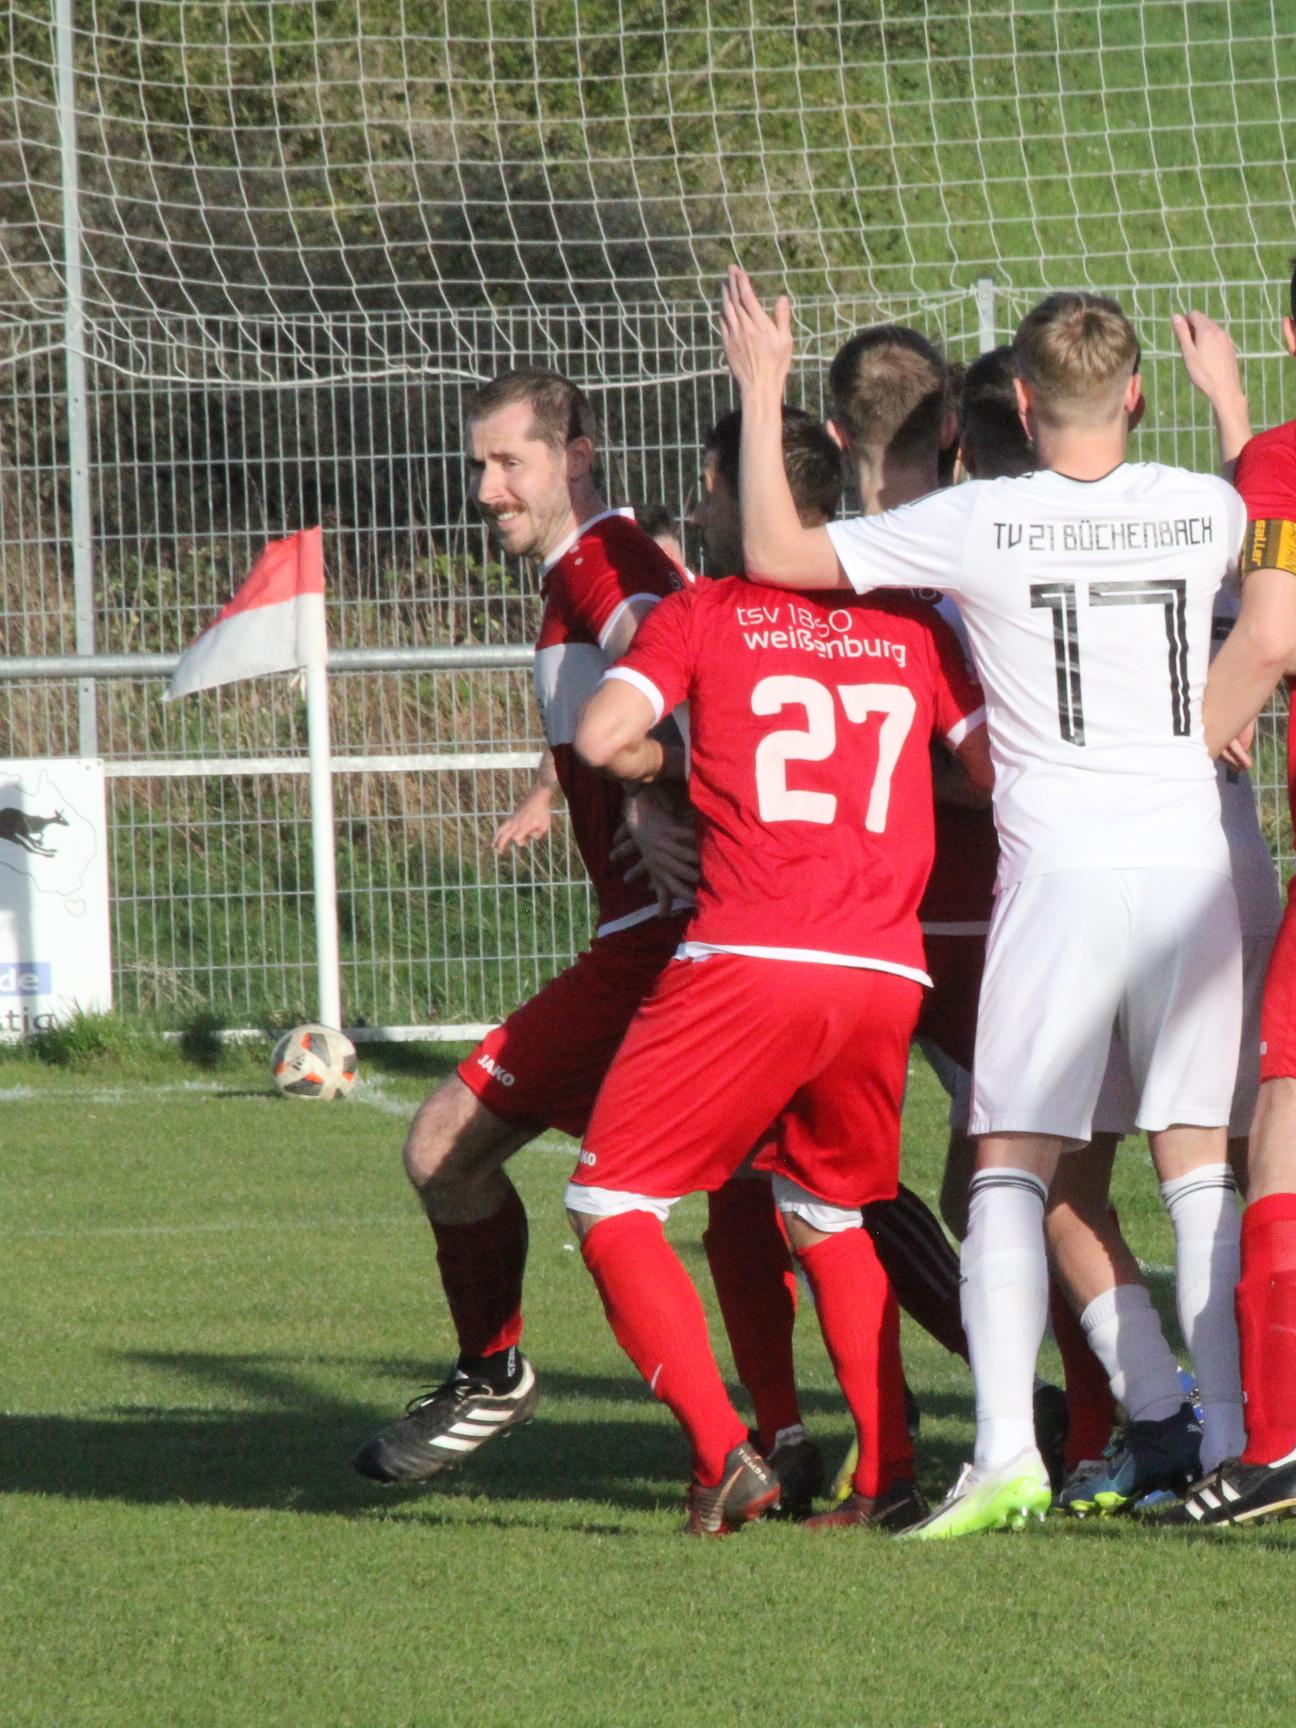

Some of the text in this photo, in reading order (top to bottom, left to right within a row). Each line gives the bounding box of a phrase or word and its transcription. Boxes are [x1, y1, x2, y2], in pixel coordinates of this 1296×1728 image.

[993, 516, 1213, 551] TV 21 BÜCHENBACH
[736, 605, 780, 627] tsv
[743, 625, 907, 668] weißenburg
[1029, 578, 1191, 747] 17
[750, 674, 917, 834] 27
[477, 1054, 515, 1087] JAKO
